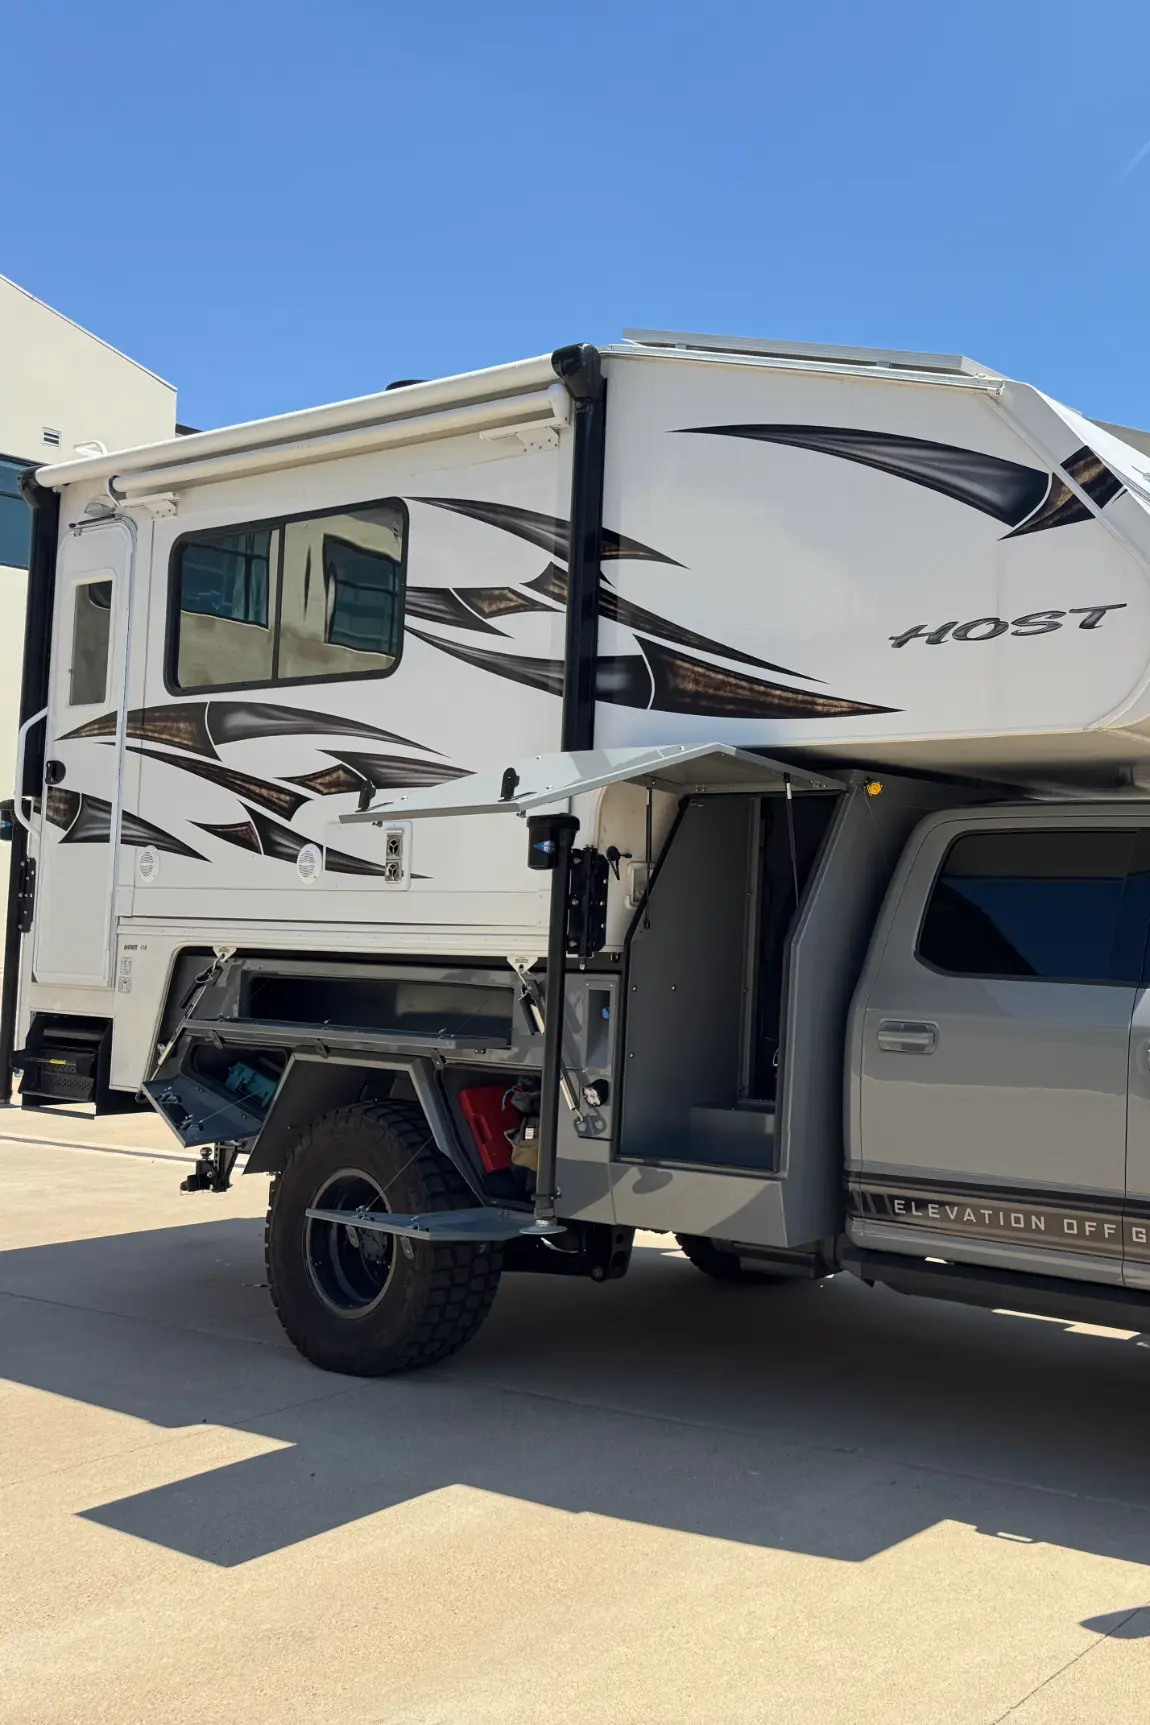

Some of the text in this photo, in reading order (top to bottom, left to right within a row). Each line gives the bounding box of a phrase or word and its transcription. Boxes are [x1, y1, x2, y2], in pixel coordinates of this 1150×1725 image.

[889, 603, 1128, 648] HOST
[894, 1199, 1046, 1231] ELEVATION
[1063, 1218, 1117, 1238] OFF
